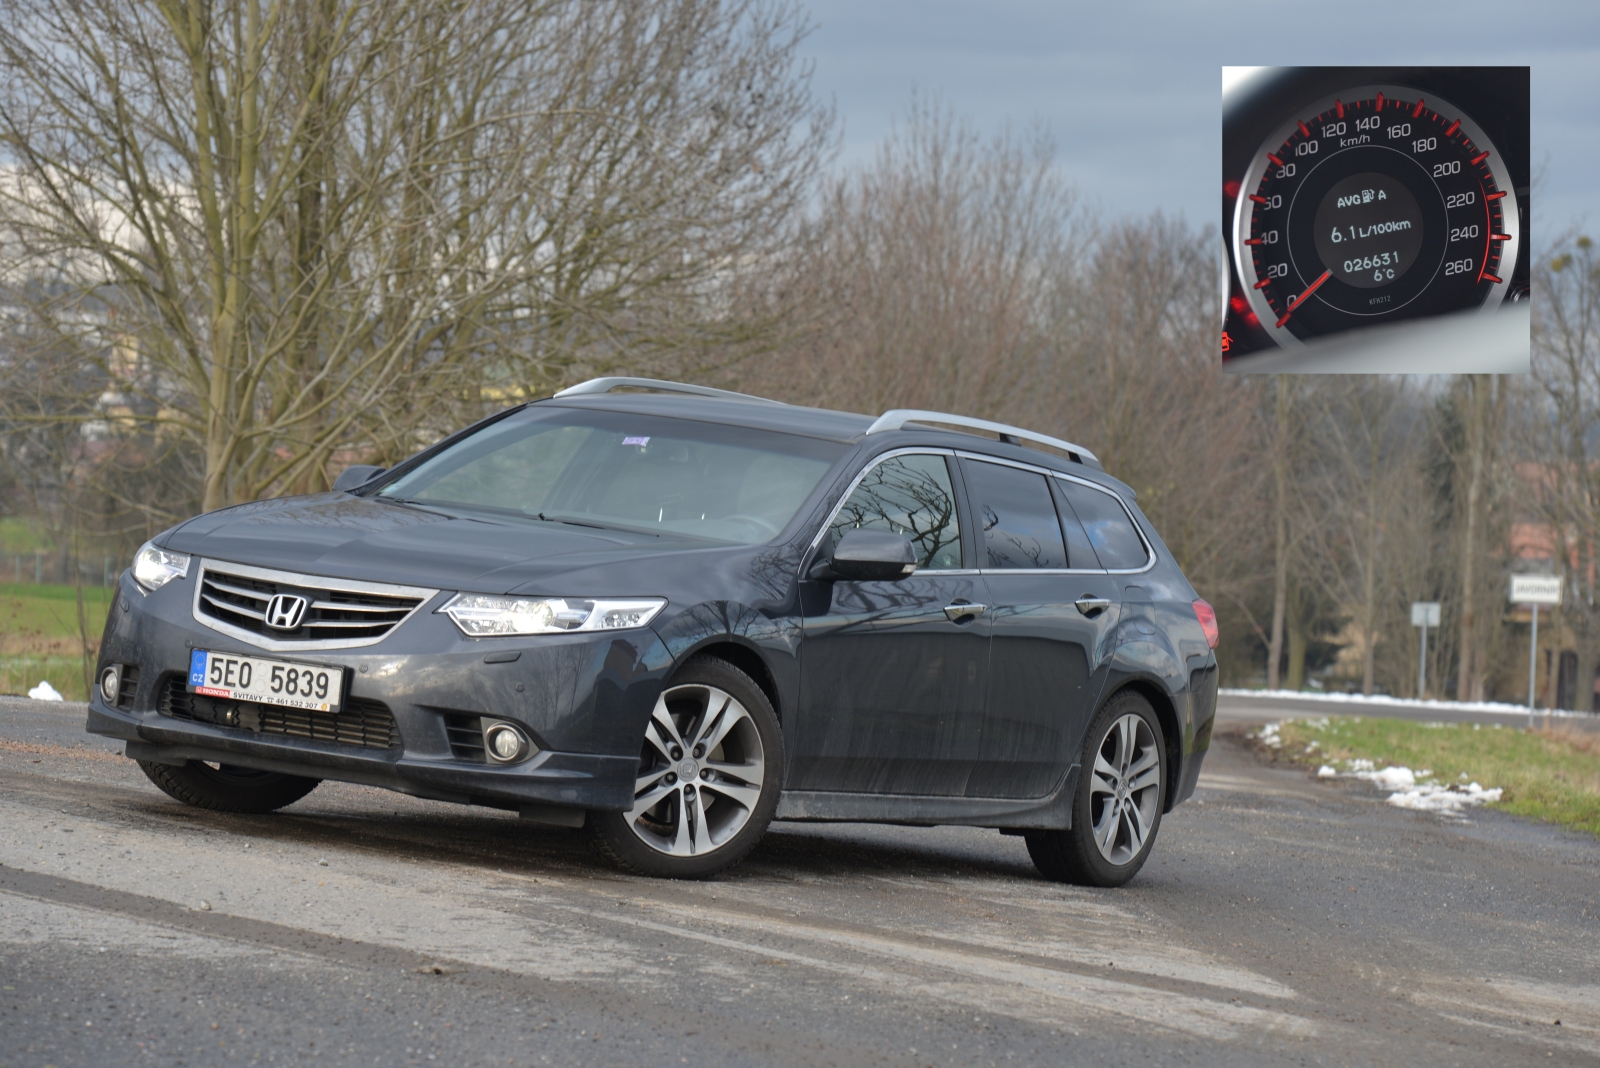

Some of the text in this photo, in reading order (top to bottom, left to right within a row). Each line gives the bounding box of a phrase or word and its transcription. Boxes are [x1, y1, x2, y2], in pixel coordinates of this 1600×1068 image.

[1321, 121, 1347, 138] 120
[1355, 115, 1381, 131] 140
[1387, 123, 1411, 139] 160
[1295, 140, 1319, 157] 100
[1340, 134, 1371, 148] km/h
[1412, 137, 1437, 153] 180
[1275, 163, 1296, 179] 80
[1433, 160, 1461, 178] 200
[1337, 189, 1387, 208] AVG A
[1446, 191, 1475, 209] 220
[1261, 230, 1279, 245] 40
[1330, 219, 1411, 243] 6.1 L/100km
[1450, 224, 1479, 242] 240
[1267, 262, 1288, 279] 20
[1344, 251, 1400, 273] 026631
[1445, 258, 1473, 275] 260
[192, 673, 203, 683] CZ
[209, 657, 329, 699] 5E0 5839
[202, 688, 229, 697] HONDA
[233, 692, 263, 702] SVITAVY
